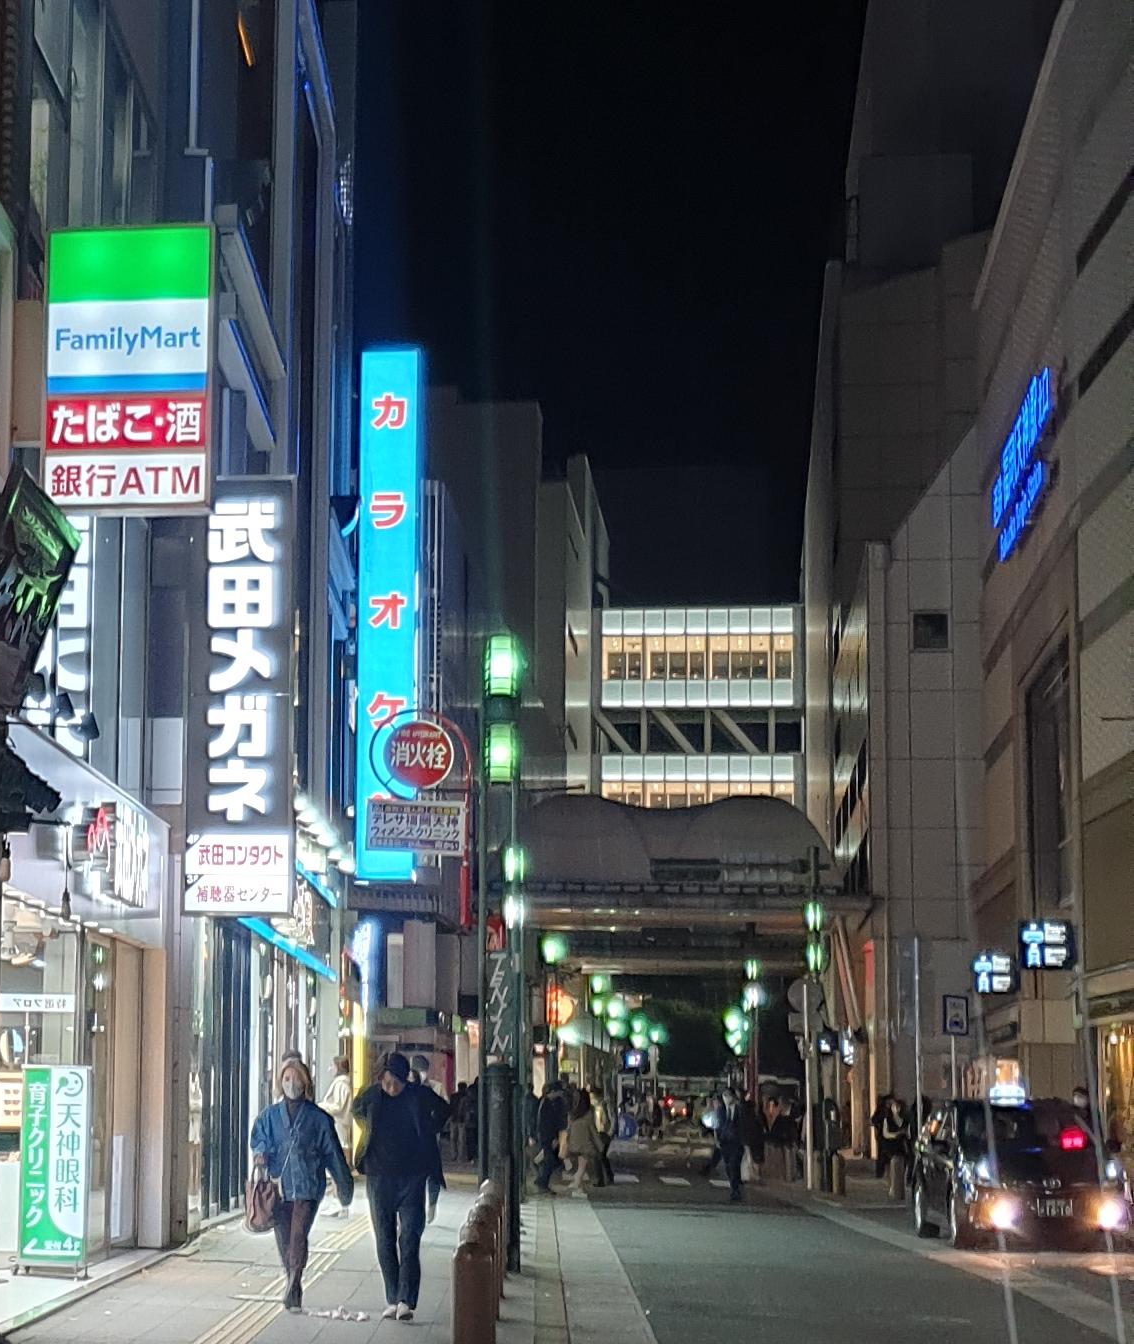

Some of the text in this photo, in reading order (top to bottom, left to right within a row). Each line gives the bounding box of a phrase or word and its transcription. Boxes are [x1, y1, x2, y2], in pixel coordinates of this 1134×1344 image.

[55, 325, 201, 356] FamilyMart
[51, 464, 201, 498] 銀行ATM
[207, 500, 276, 821] 武田メガネ
[390, 741, 447, 769] 消火栓
[198, 844, 284, 866] 武田コンタクト
[196, 885, 283, 903] 補聴器センター
[25, 1082, 48, 1228] 育子クリニック
[54, 1103, 83, 1214] 天神眼科
